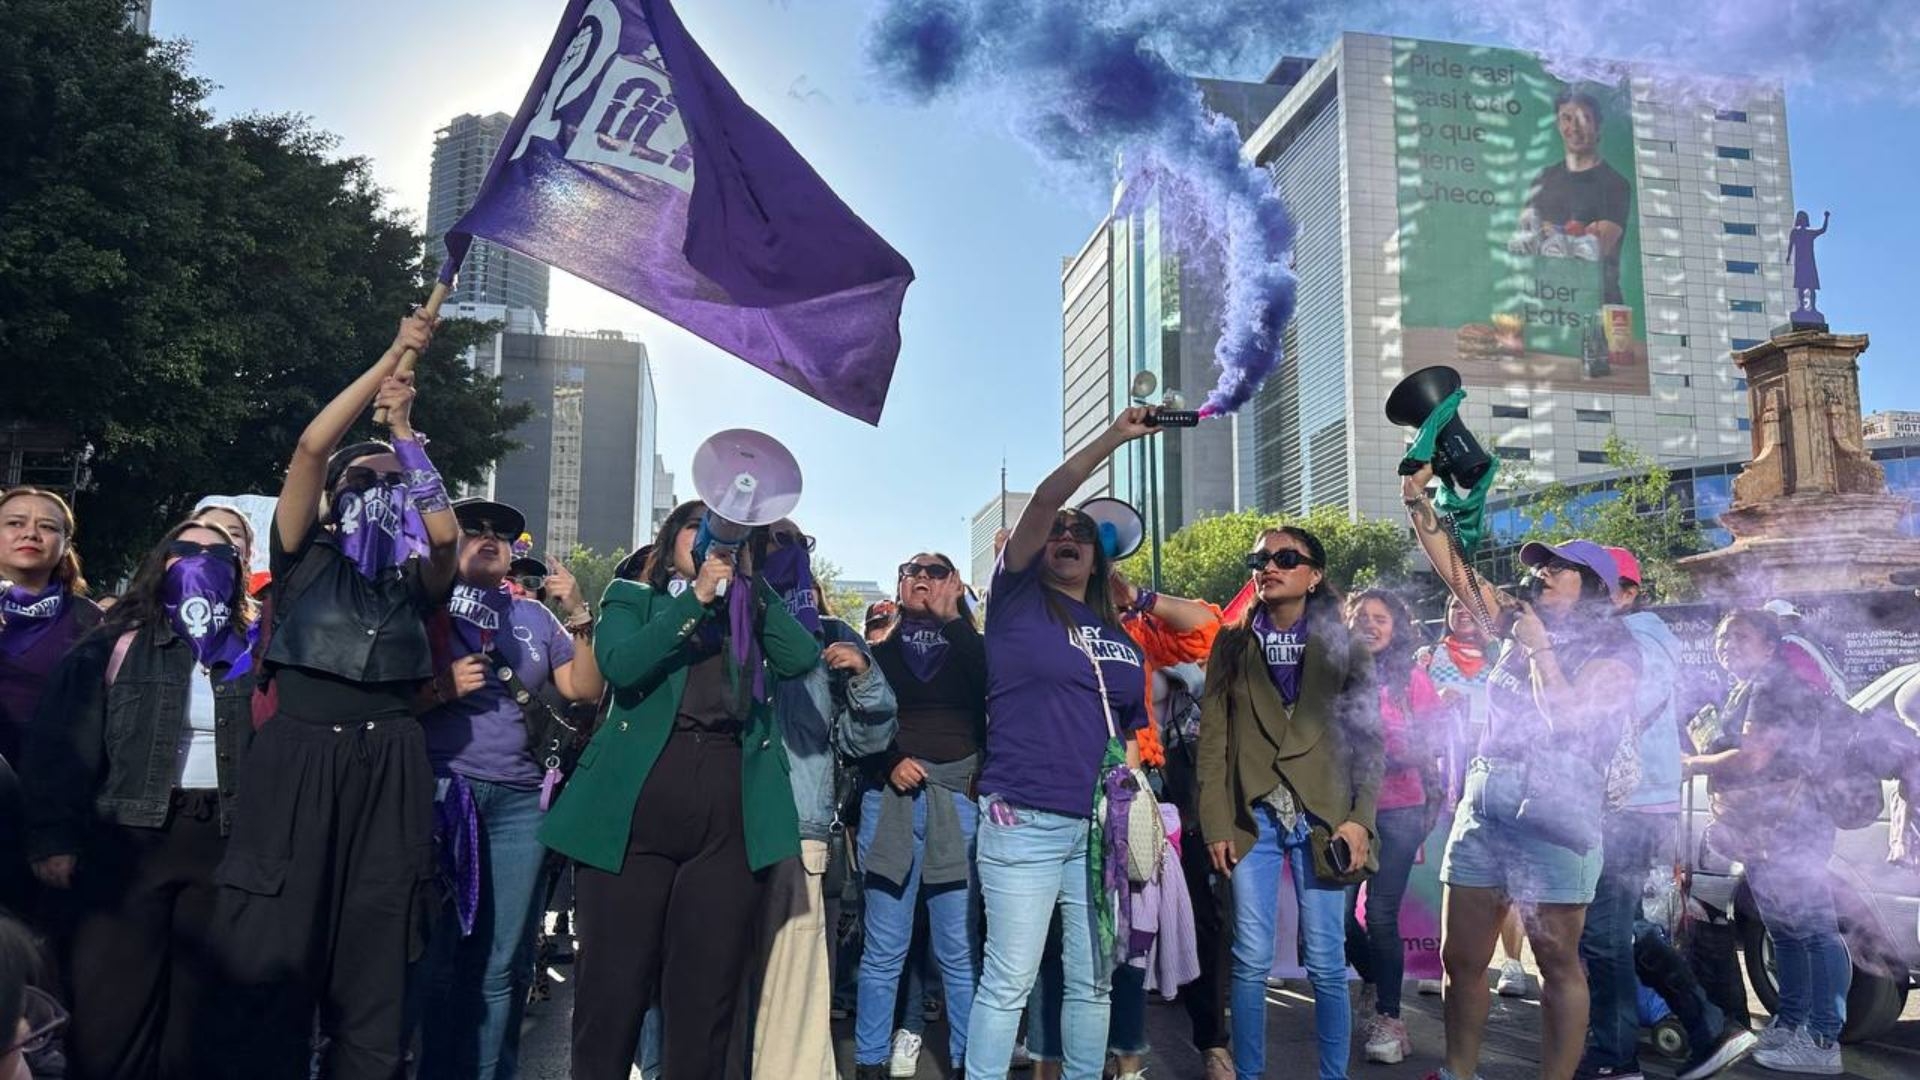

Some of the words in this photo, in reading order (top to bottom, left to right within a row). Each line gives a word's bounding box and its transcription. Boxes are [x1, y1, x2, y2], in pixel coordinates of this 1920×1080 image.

[1410, 54, 1463, 79] Pide
[1414, 88, 1457, 109] casi
[1440, 124, 1487, 146] que
[1524, 279, 1580, 303] Uber
[1525, 302, 1581, 328] Eats
[1069, 628, 1140, 667] OMPIA
